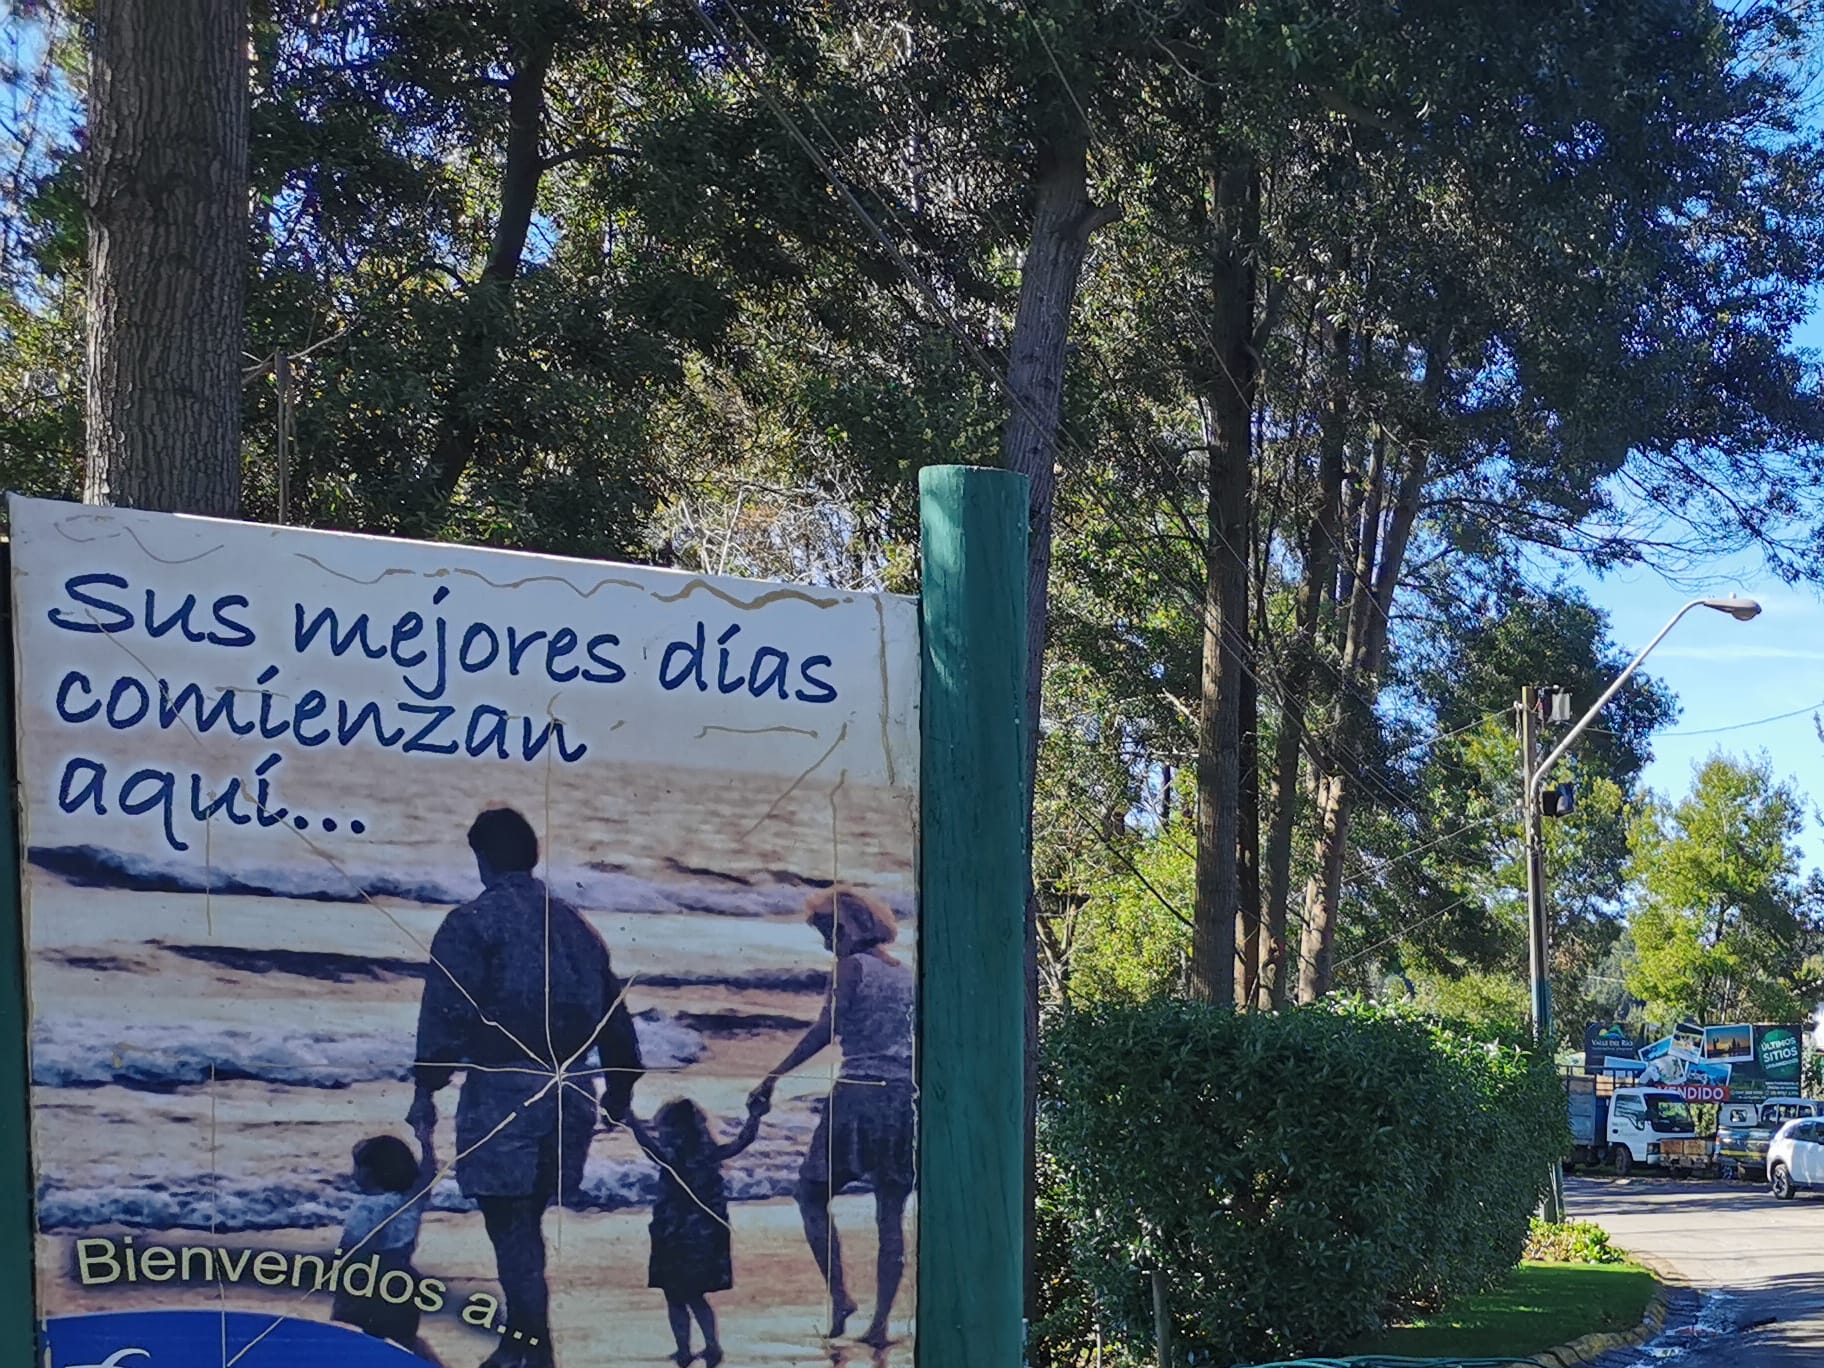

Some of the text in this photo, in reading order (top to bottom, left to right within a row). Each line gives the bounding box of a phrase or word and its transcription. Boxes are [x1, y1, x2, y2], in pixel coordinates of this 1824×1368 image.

[46, 571, 839, 705] Sus mejores días
[57, 751, 367, 852] aquí...
[1658, 1086, 1724, 1100] NDIDO
[1763, 1046, 1798, 1063] SITIOS
[76, 1236, 540, 1347] Bienvenidos a...
